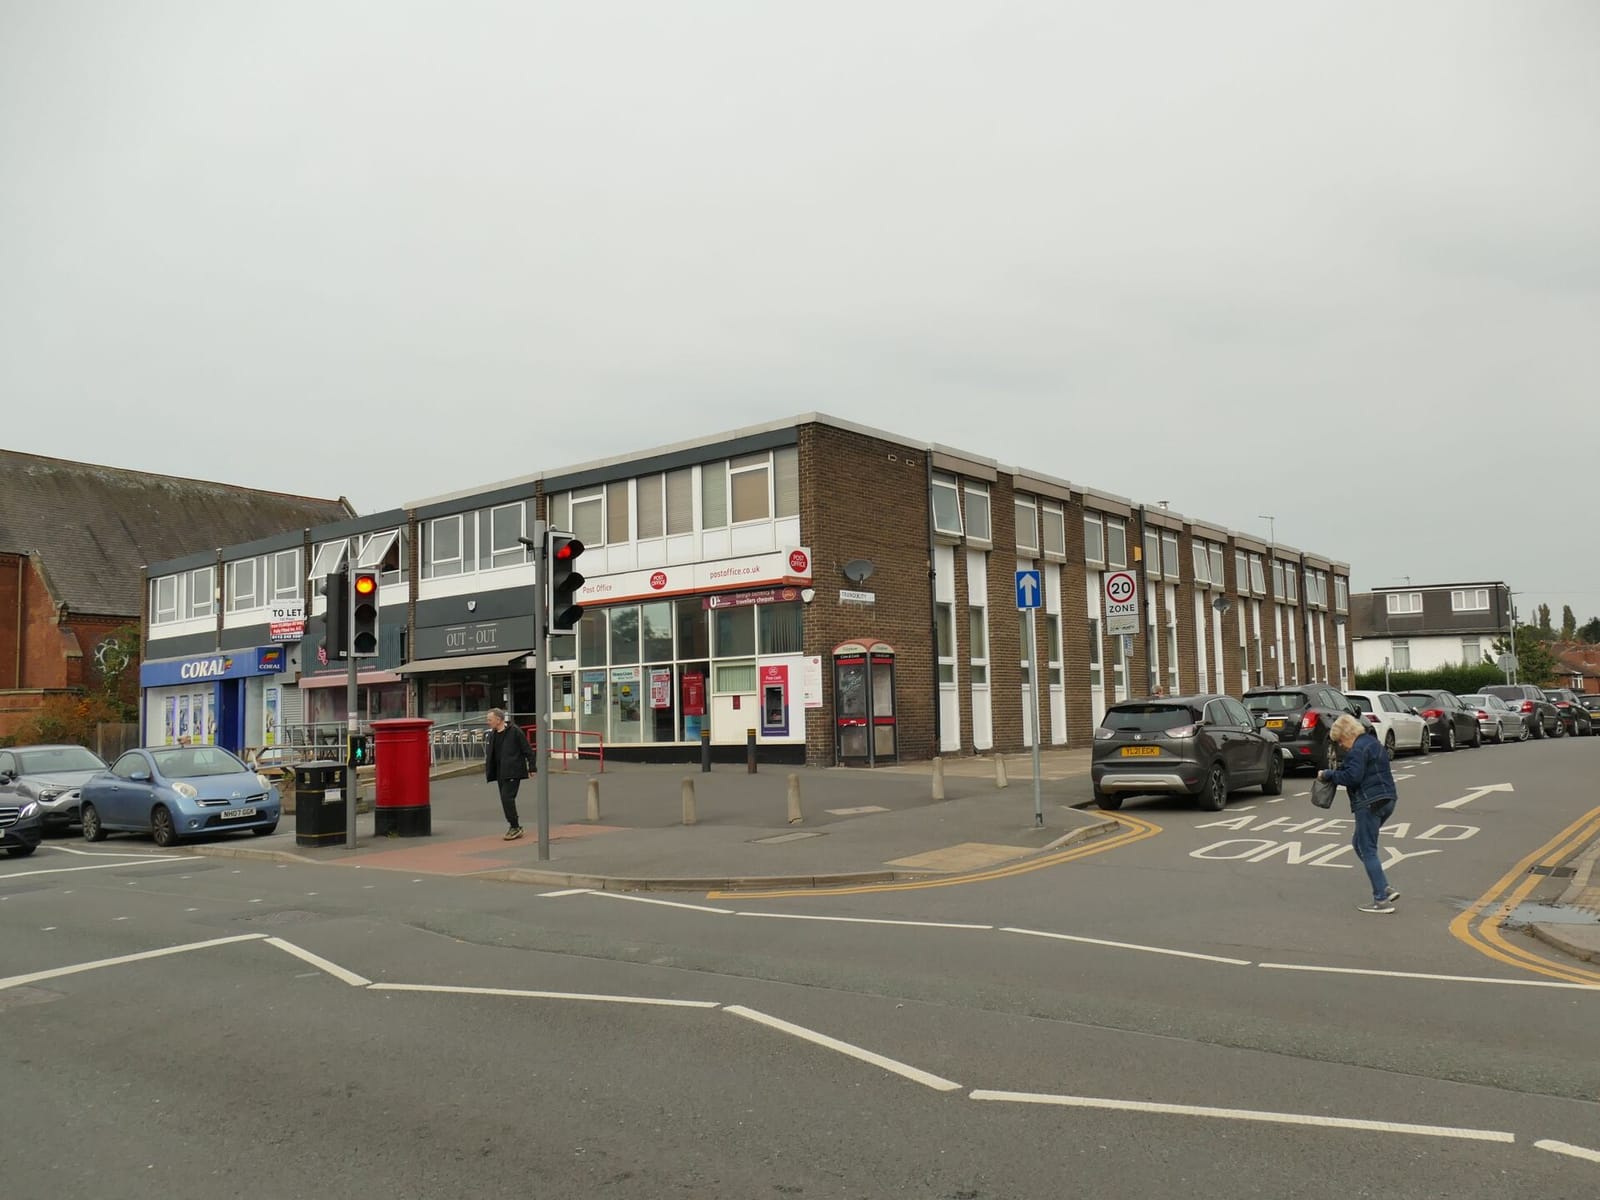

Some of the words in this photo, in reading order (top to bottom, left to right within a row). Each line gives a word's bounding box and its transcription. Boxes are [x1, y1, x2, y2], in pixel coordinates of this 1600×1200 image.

[790, 560, 806, 568] OFFICE
[709, 565, 760, 580] postoffice.co.uk
[583, 586, 595, 594] Post
[596, 584, 612, 593] Office
[651, 579, 666, 587] OFFICE
[1111, 581, 1131, 595] 20
[272, 609, 284, 617] TO
[286, 608, 302, 617] LET
[1109, 604, 1135, 613] ZONE
[446, 632, 467, 647] OUT
[476, 629, 497, 644] OUT
[181, 659, 225, 679] CORAL
[1195, 815, 1481, 841] AHEAD
[1189, 838, 1444, 872] ONLY
